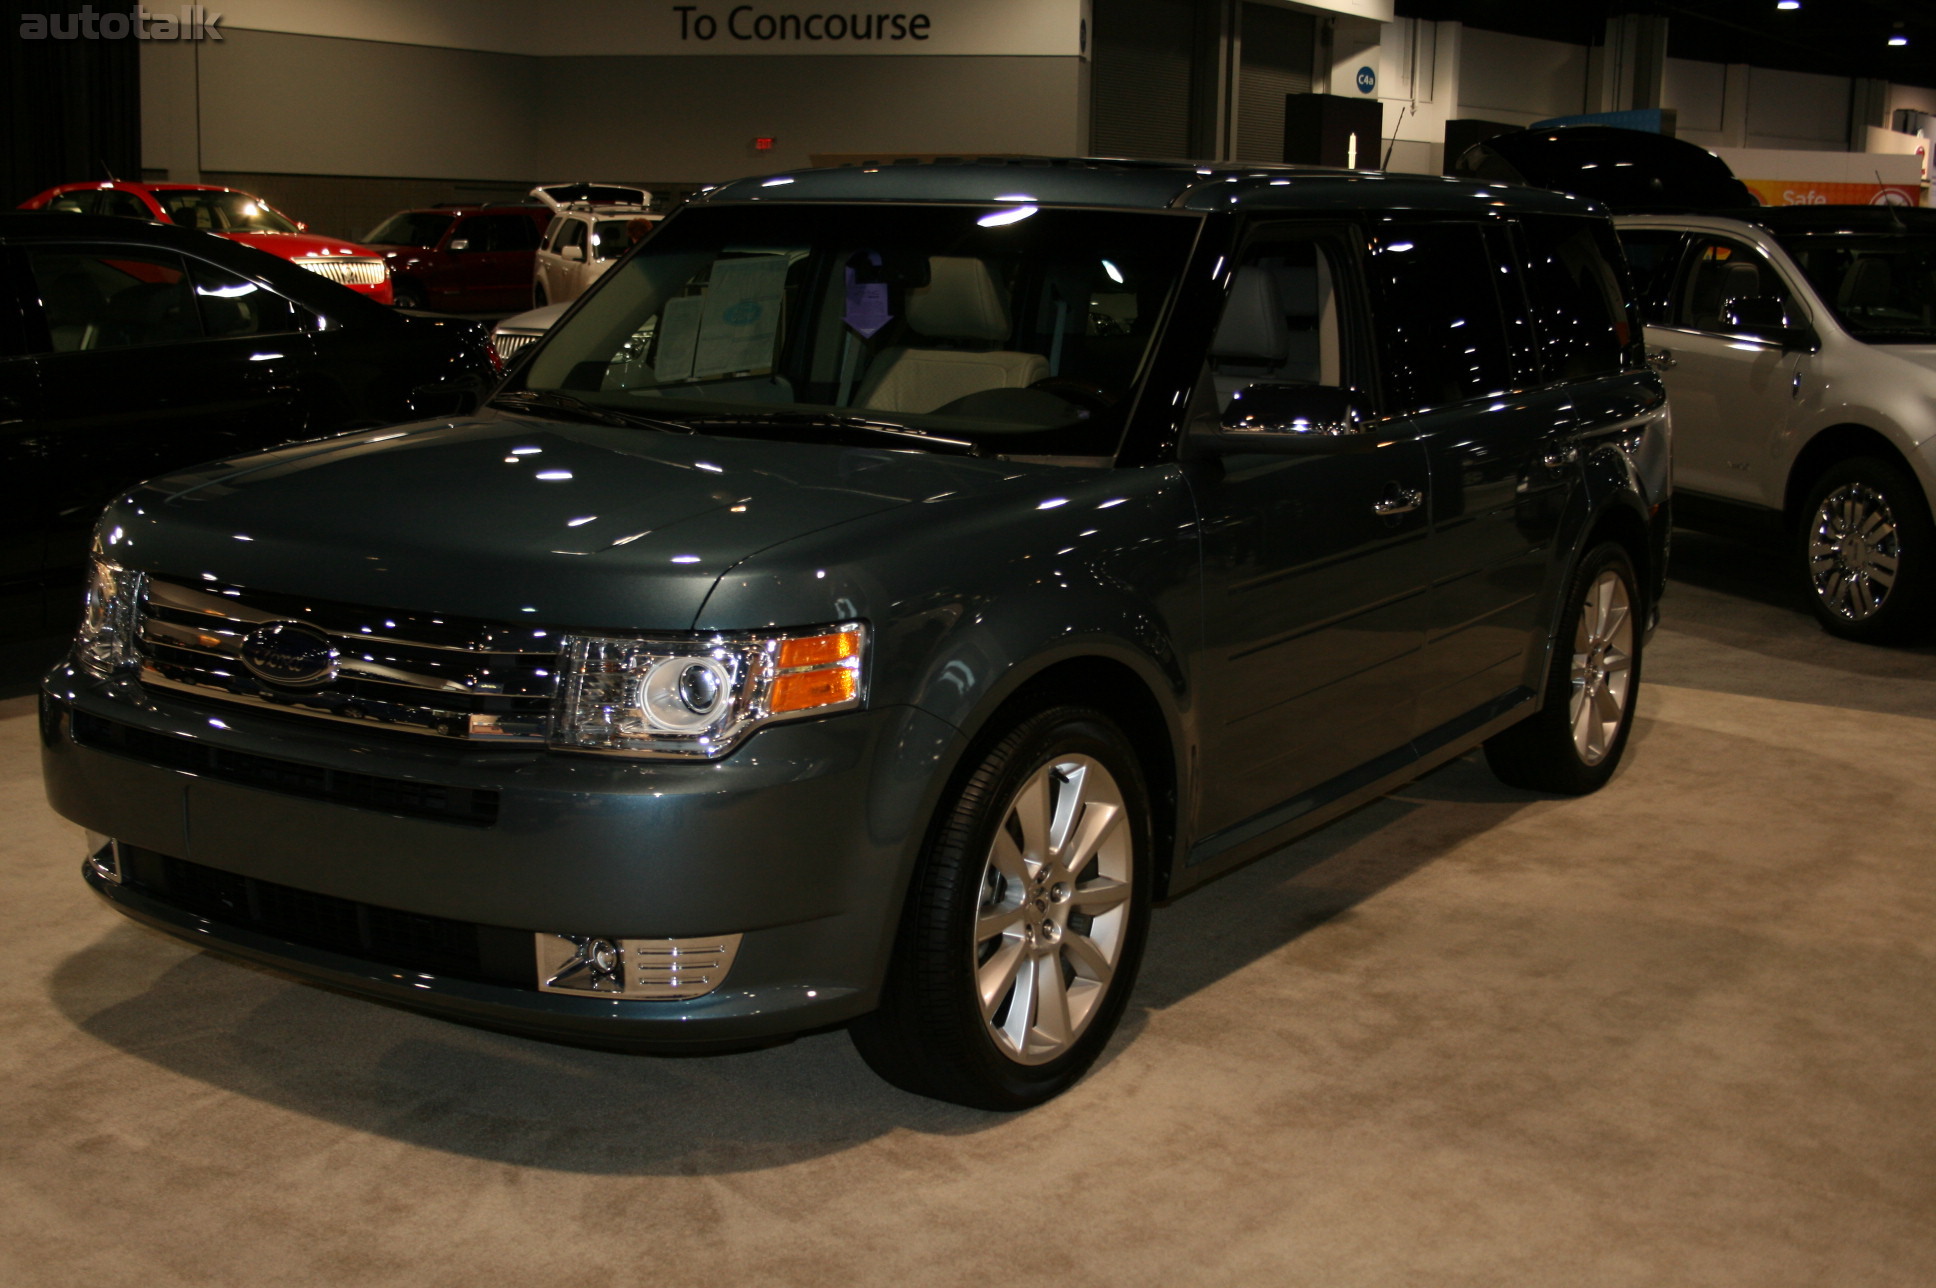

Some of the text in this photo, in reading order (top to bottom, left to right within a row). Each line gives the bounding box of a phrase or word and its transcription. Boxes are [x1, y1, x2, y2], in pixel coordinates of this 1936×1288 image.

[673, 5, 932, 41] To Concourse
[1358, 74, 1374, 86] C4a
[1782, 190, 1828, 206] Safe
